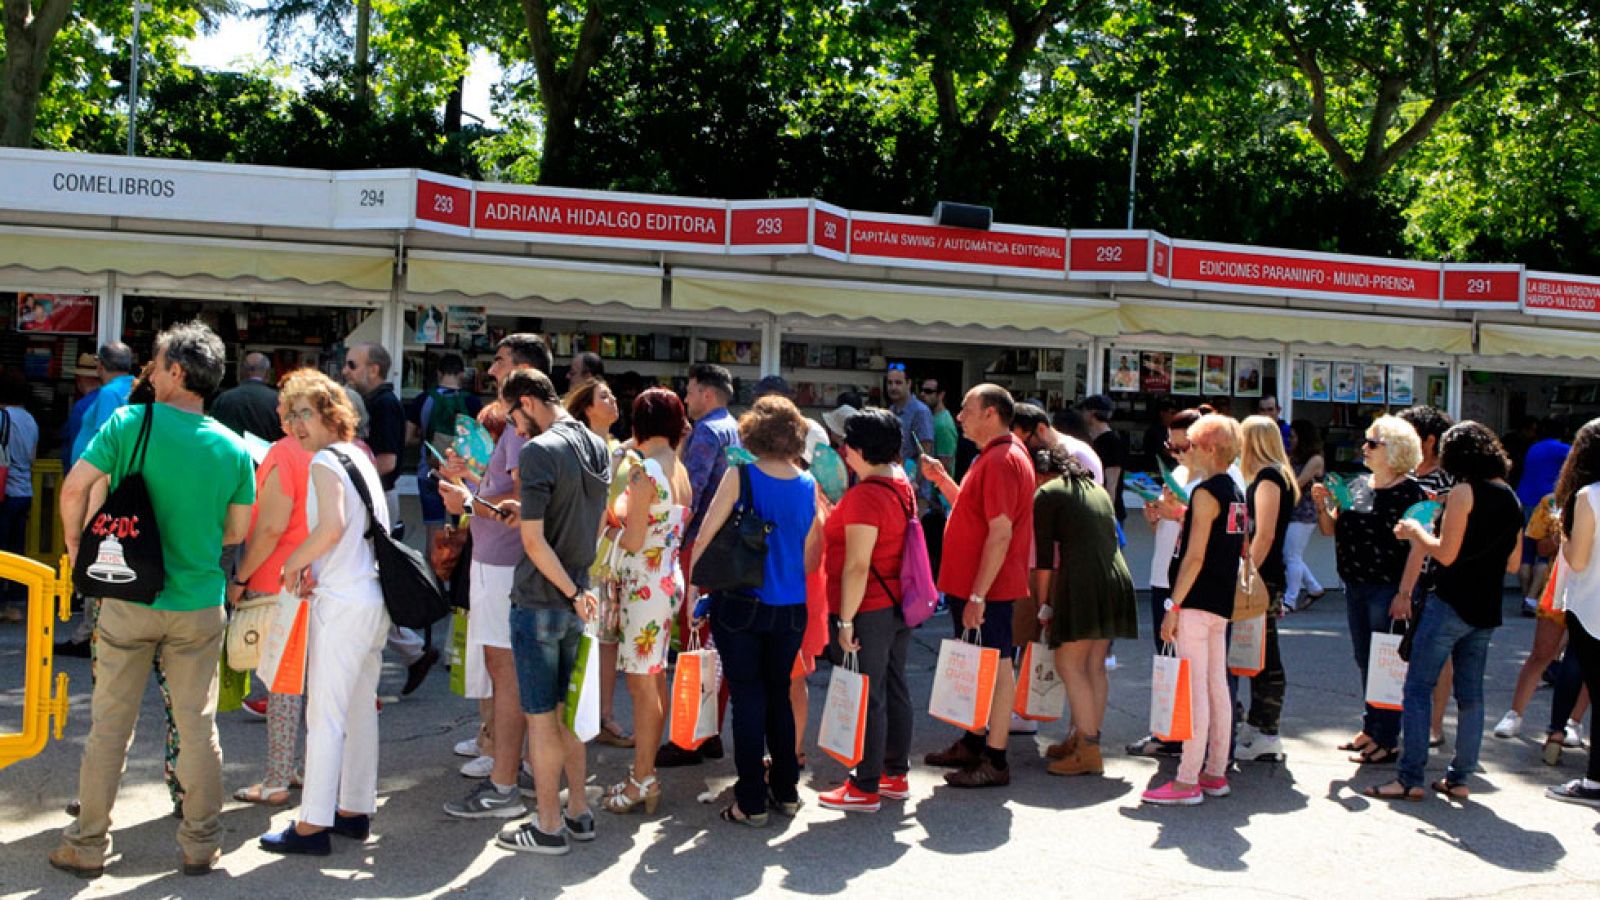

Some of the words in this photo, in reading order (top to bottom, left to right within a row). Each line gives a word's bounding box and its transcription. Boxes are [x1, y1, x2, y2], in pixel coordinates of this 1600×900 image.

[53, 172, 175, 198] COMELIBROS
[360, 189, 384, 207] 294
[433, 193, 453, 212] 293
[484, 202, 561, 224] ADRIANA
[567, 207, 640, 229] HIDALGO
[646, 213, 716, 234] EDITORA
[756, 217, 782, 235] 293
[853, 229, 899, 244] CAPITÁN
[901, 233, 935, 249] SWING
[944, 237, 1010, 253] AUTOMÁTICA
[1011, 244, 1062, 259] EDITORIAL
[1096, 246, 1122, 262] 292
[1199, 260, 1260, 279] EDICIONES
[1261, 266, 1325, 284] PARANINFO
[1333, 272, 1416, 292] MUNDI-PRENSA
[1467, 278, 1491, 294] 291
